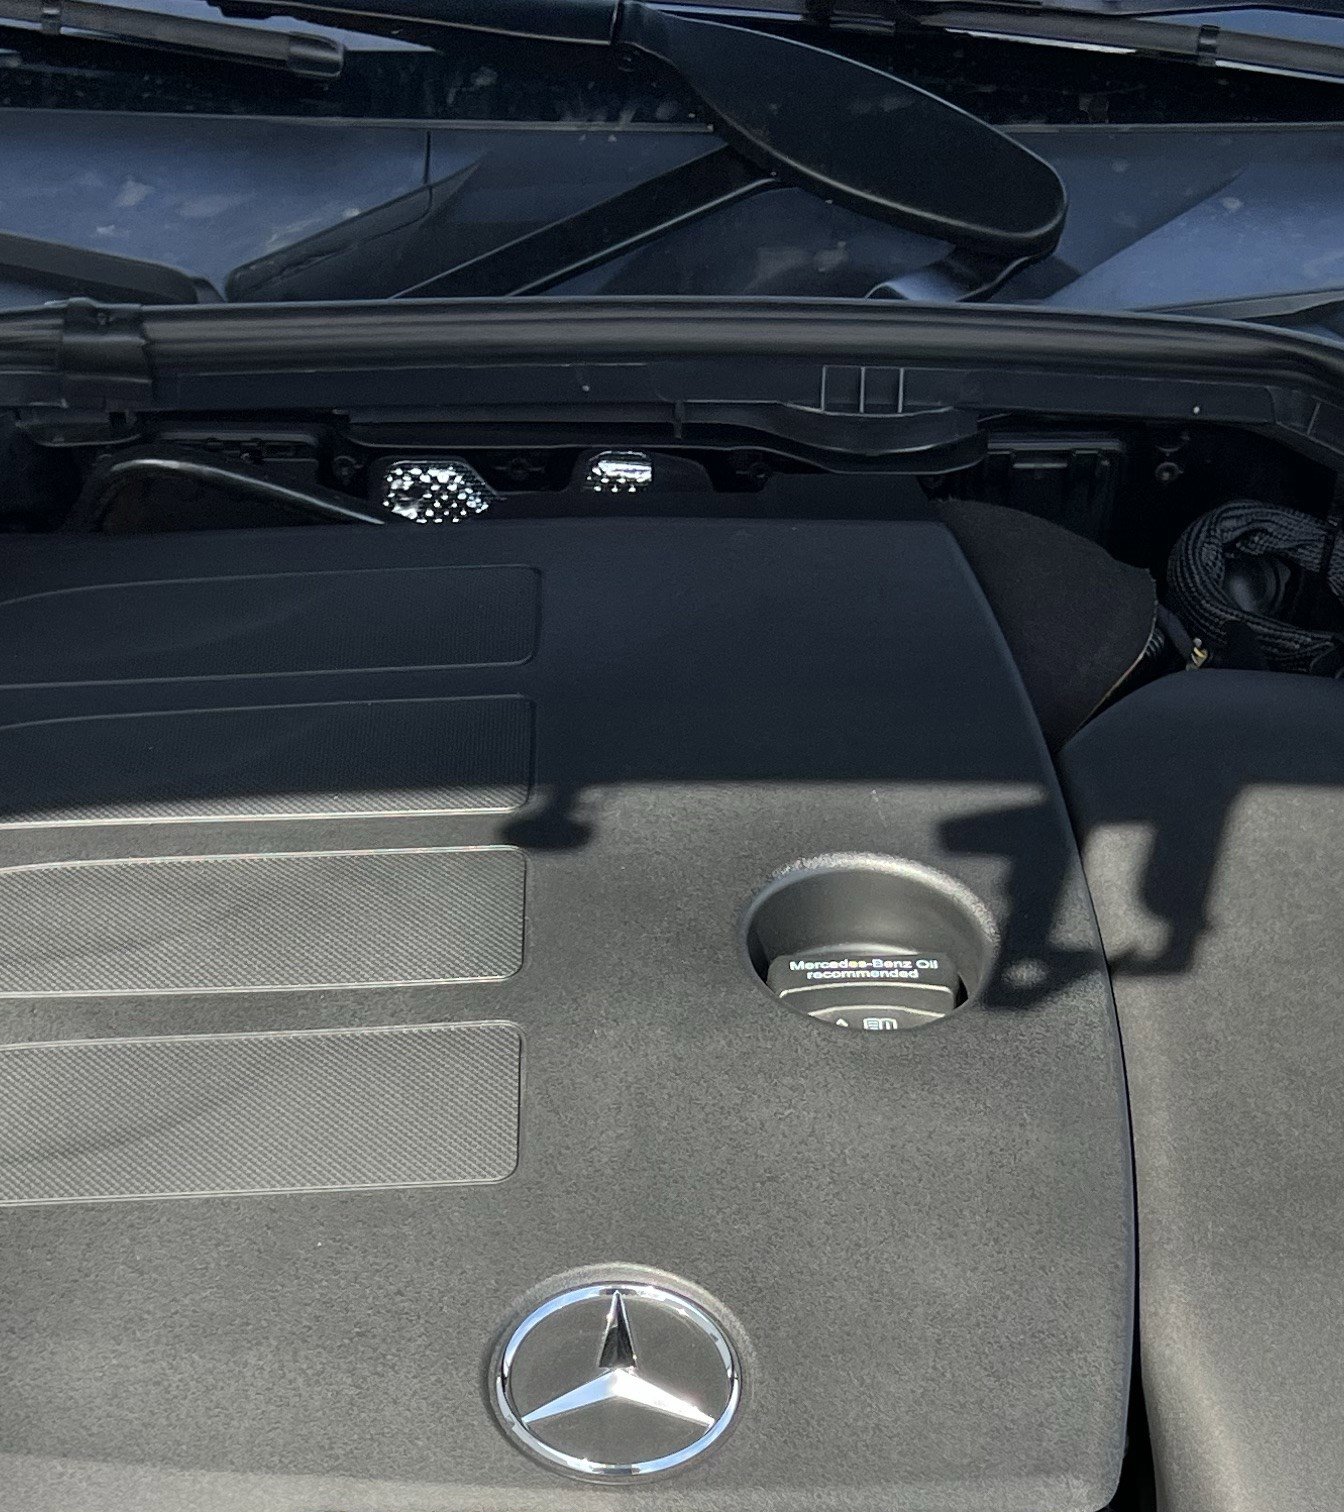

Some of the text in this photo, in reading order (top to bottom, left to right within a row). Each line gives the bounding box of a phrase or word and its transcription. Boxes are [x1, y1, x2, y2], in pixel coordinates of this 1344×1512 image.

[789, 958, 939, 971] Mercedes-Benz Oil
[806, 968, 919, 980] recommended
